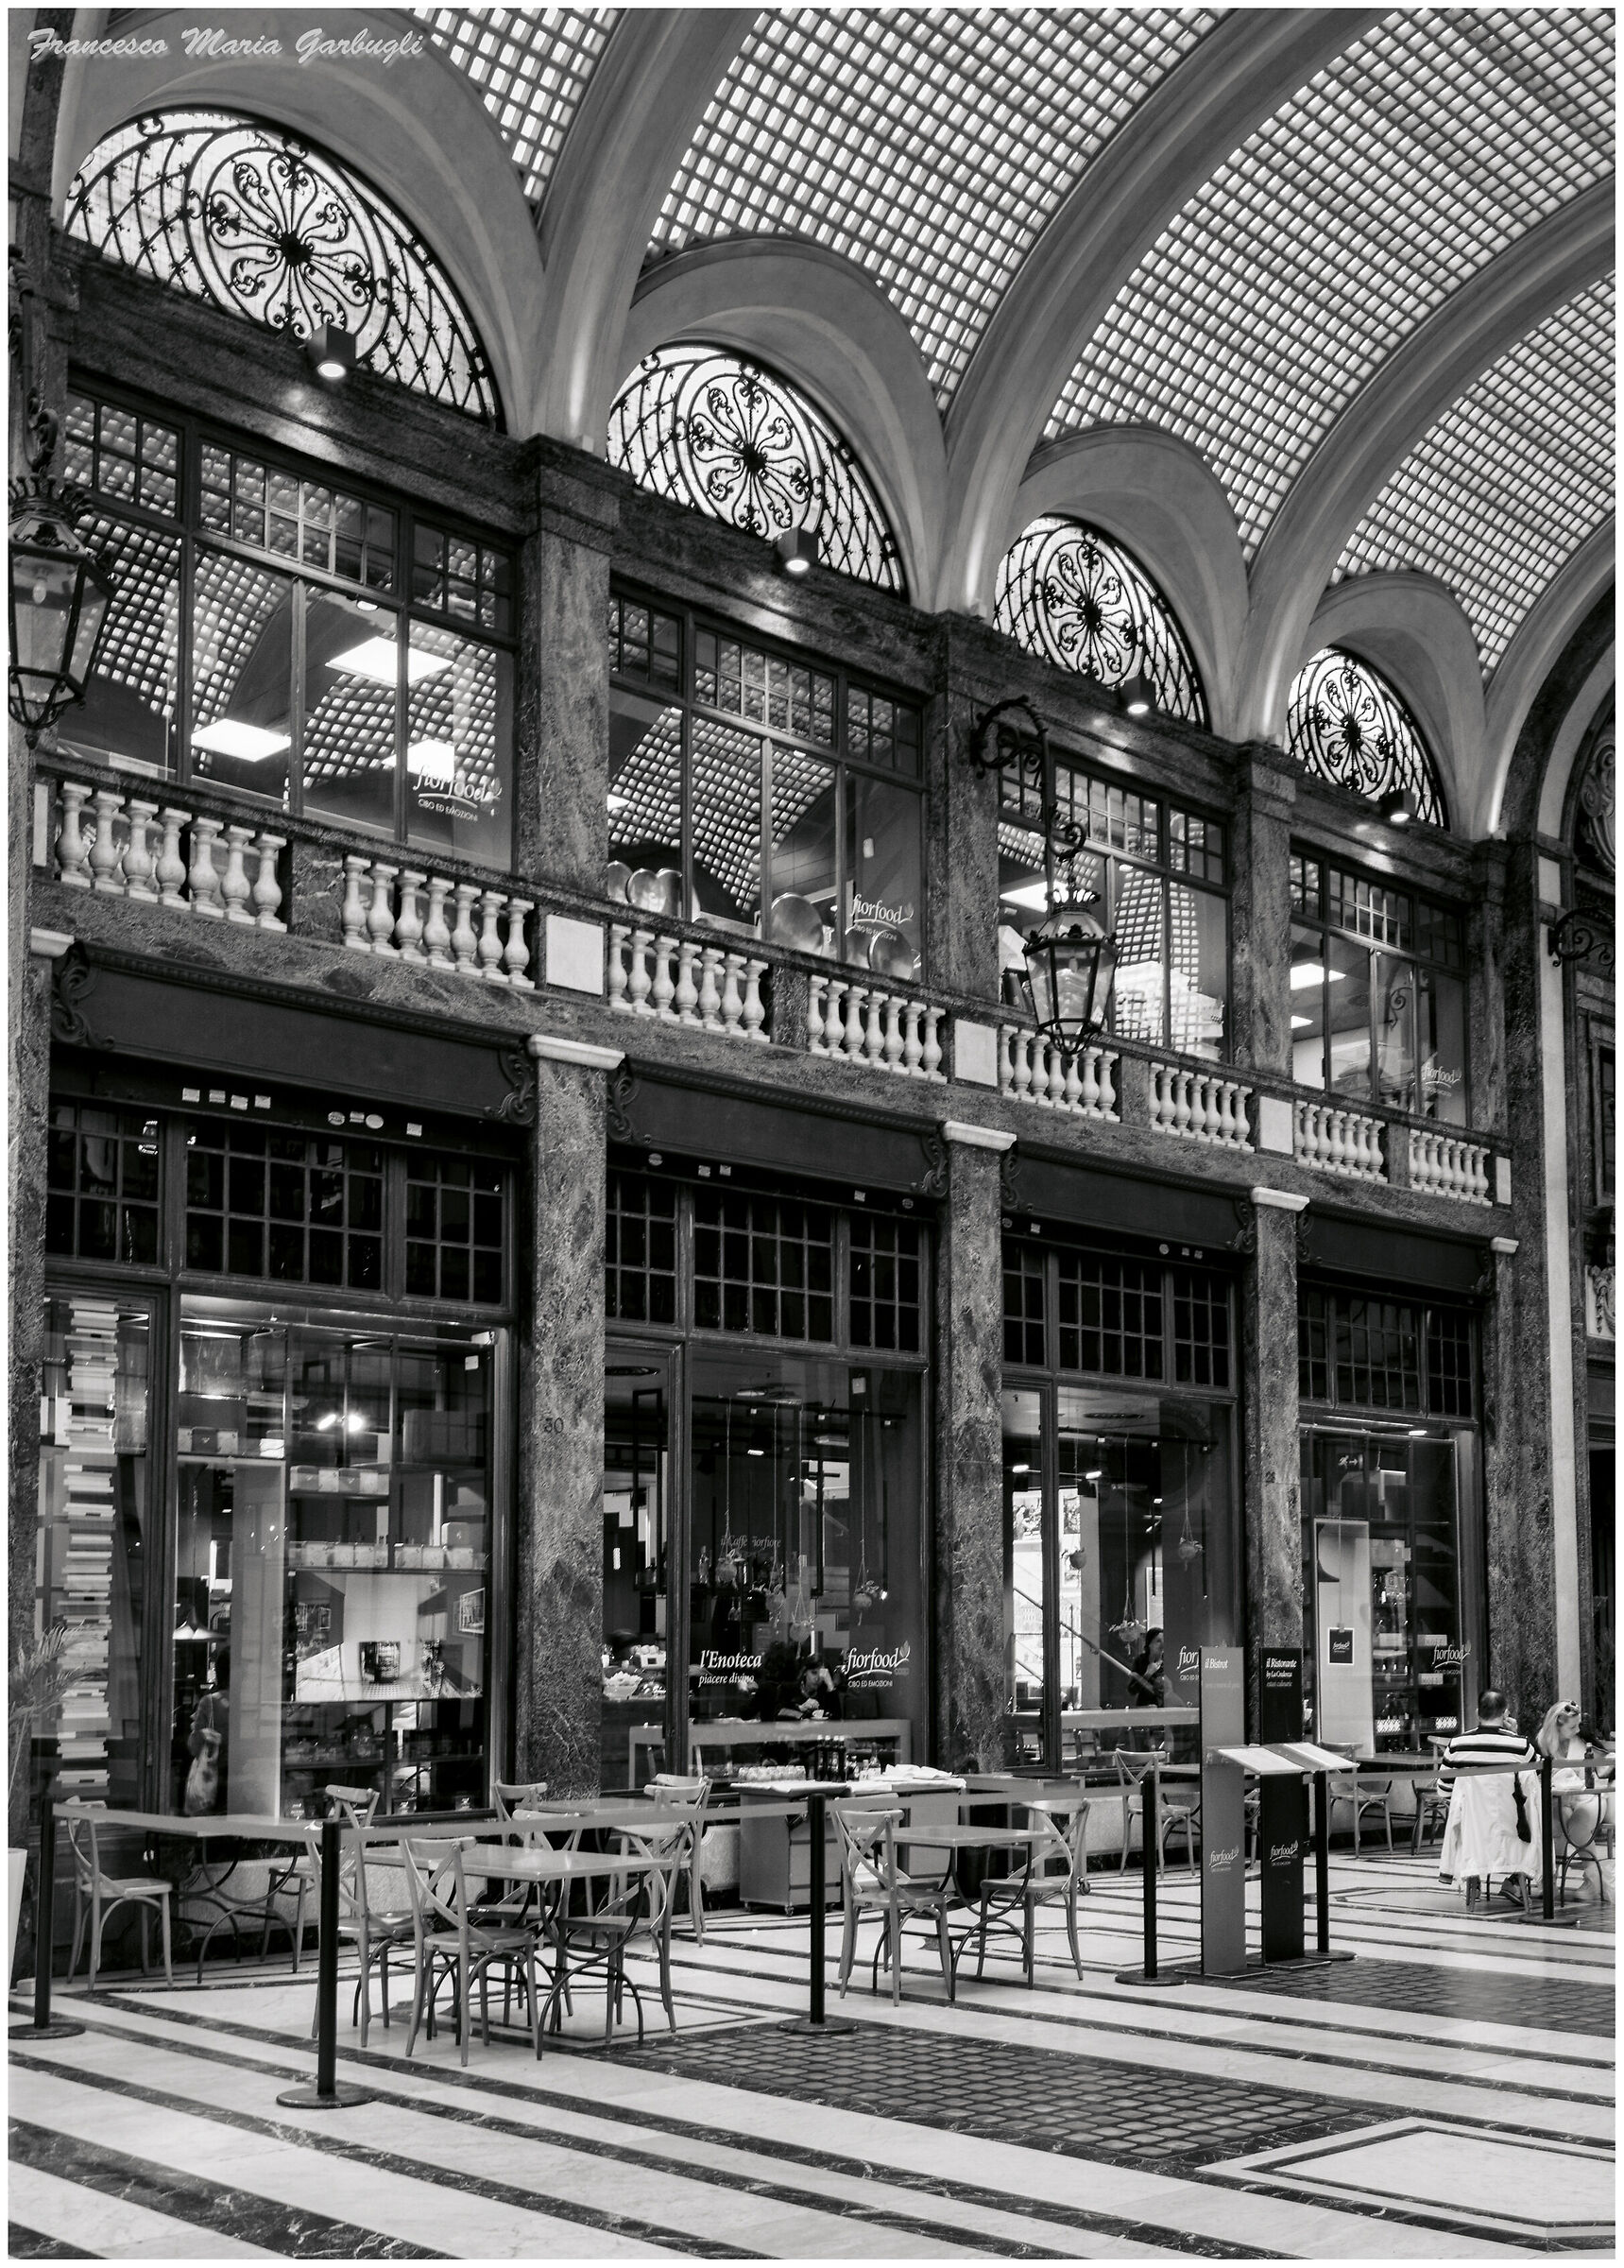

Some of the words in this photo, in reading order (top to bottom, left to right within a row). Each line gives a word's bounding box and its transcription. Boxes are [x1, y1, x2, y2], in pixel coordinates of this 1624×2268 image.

[850, 893, 907, 924] fiorfood
[700, 1649, 762, 1669] l'Enoteca
[844, 1647, 900, 1675] fiorfood
[1271, 1658, 1296, 1668] Ristorante
[1431, 1644, 1463, 1665] fiorfood
[1209, 1658, 1228, 1669] Bistrot
[698, 1673, 728, 1689] piacere
[728, 1672, 755, 1684] divino
[1209, 1849, 1235, 1866] fiorfood
[1269, 1844, 1295, 1861] fiorfood
